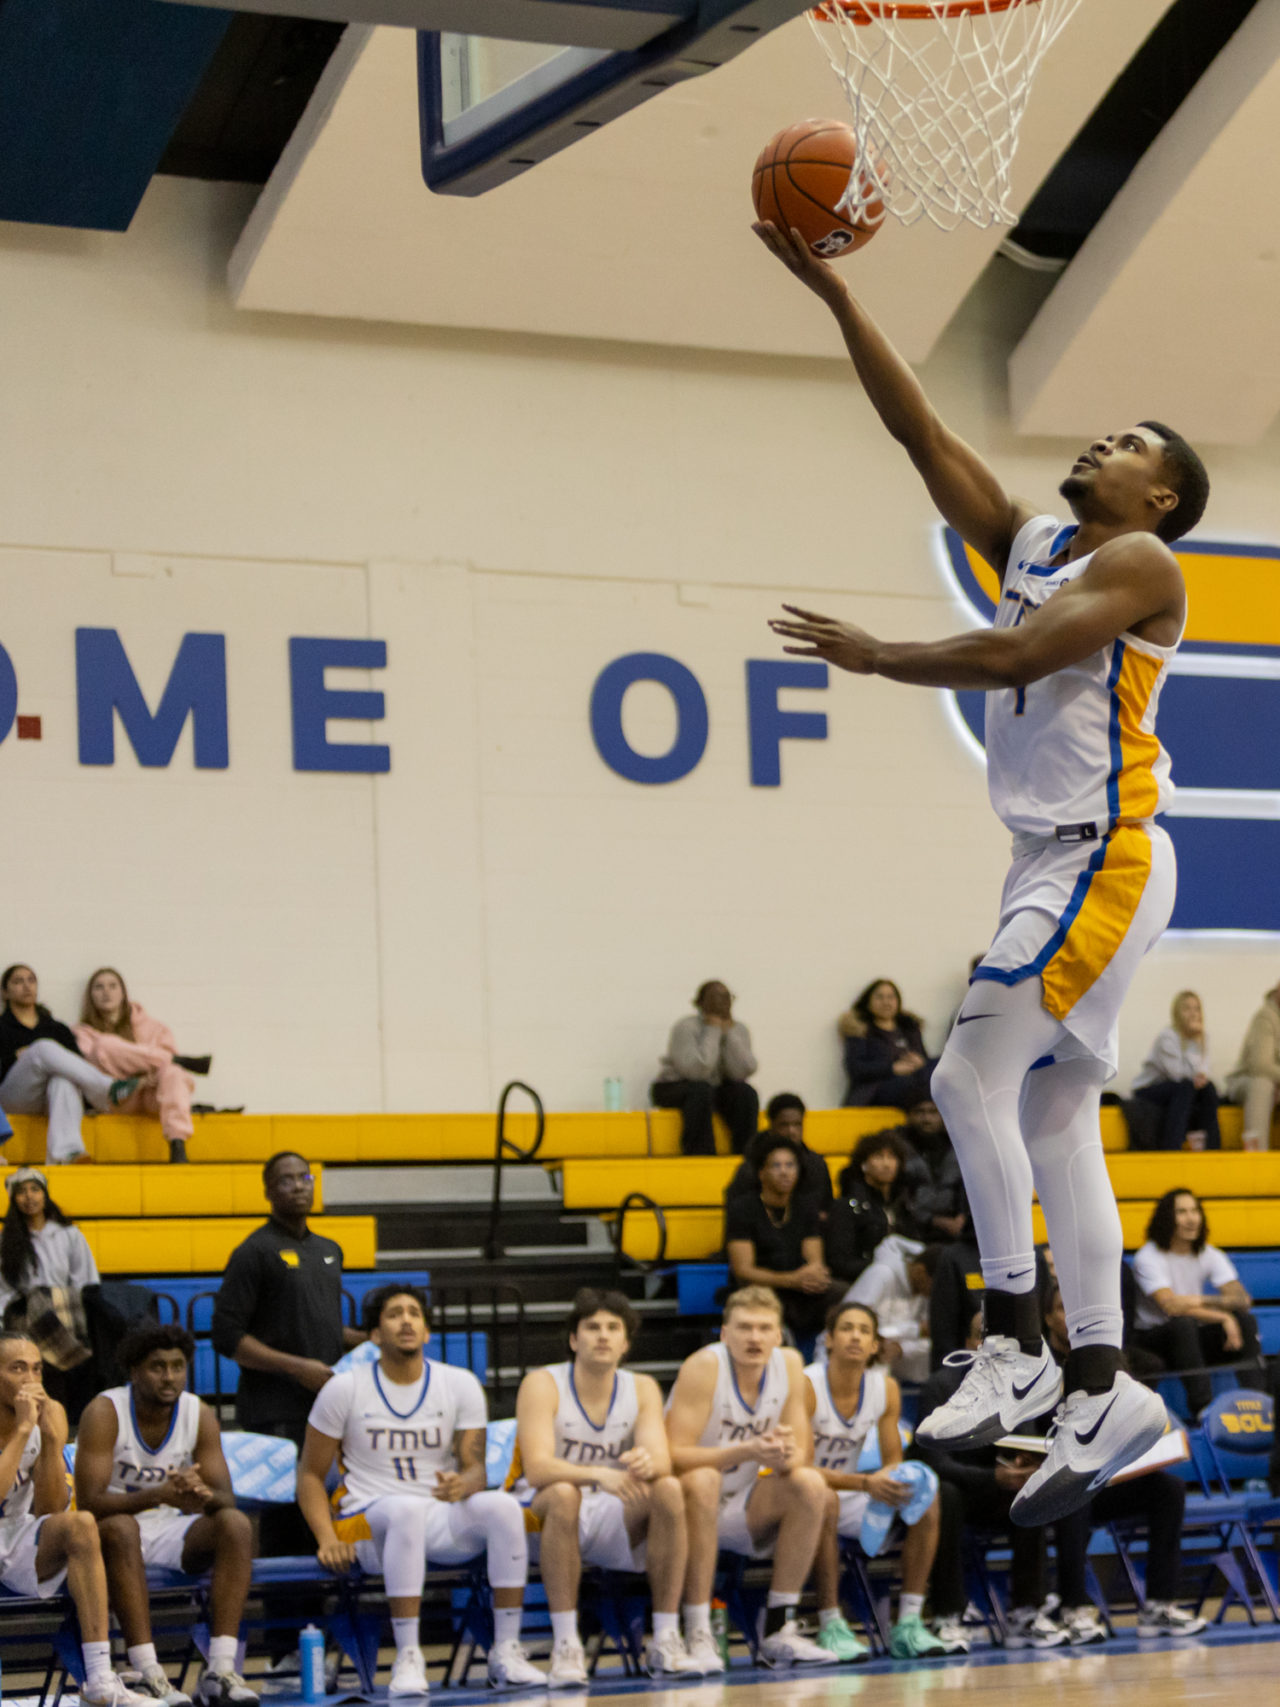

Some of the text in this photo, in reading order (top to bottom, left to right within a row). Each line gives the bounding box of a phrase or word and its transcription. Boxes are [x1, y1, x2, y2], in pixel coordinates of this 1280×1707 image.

[0, 627, 390, 773] ME
[589, 651, 829, 788] OF
[1220, 1413, 1273, 1433] BOL
[365, 1428, 441, 1451] TMU
[118, 1460, 174, 1482] TM
[392, 1456, 417, 1481] 11
